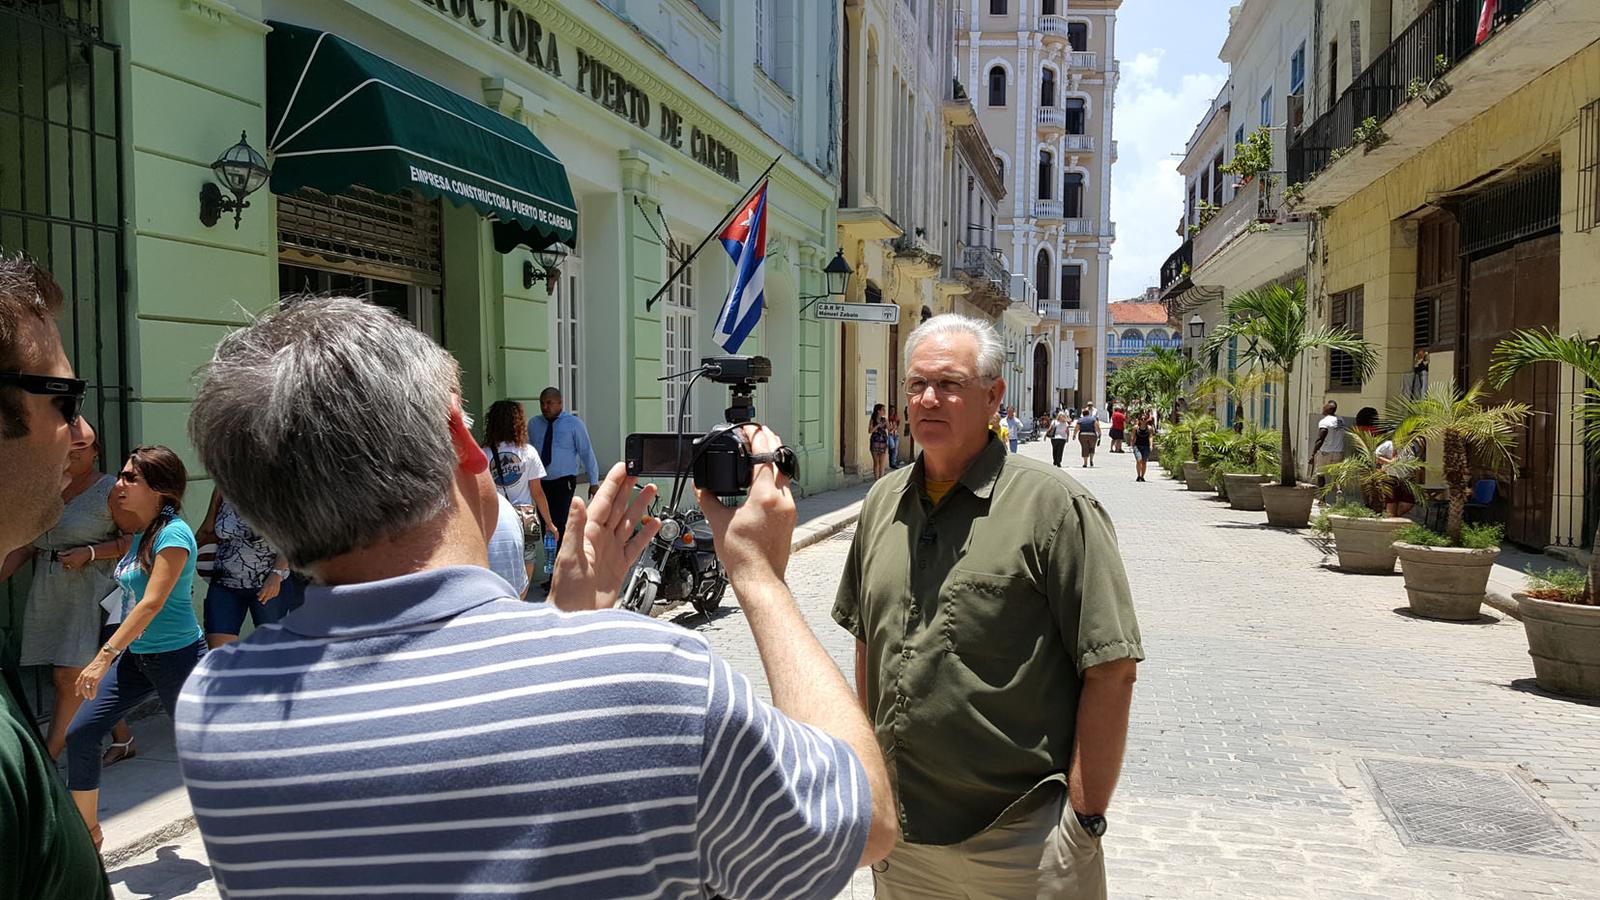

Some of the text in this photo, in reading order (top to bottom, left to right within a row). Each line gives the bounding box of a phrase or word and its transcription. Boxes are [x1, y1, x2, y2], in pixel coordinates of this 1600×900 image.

[576, 46, 650, 129] PUERTO
[660, 102, 683, 149] DE
[690, 125, 740, 183] CARENA
[409, 165, 573, 232] EMPRESA CONSTRUCTORA PUERTO DE CARENA
